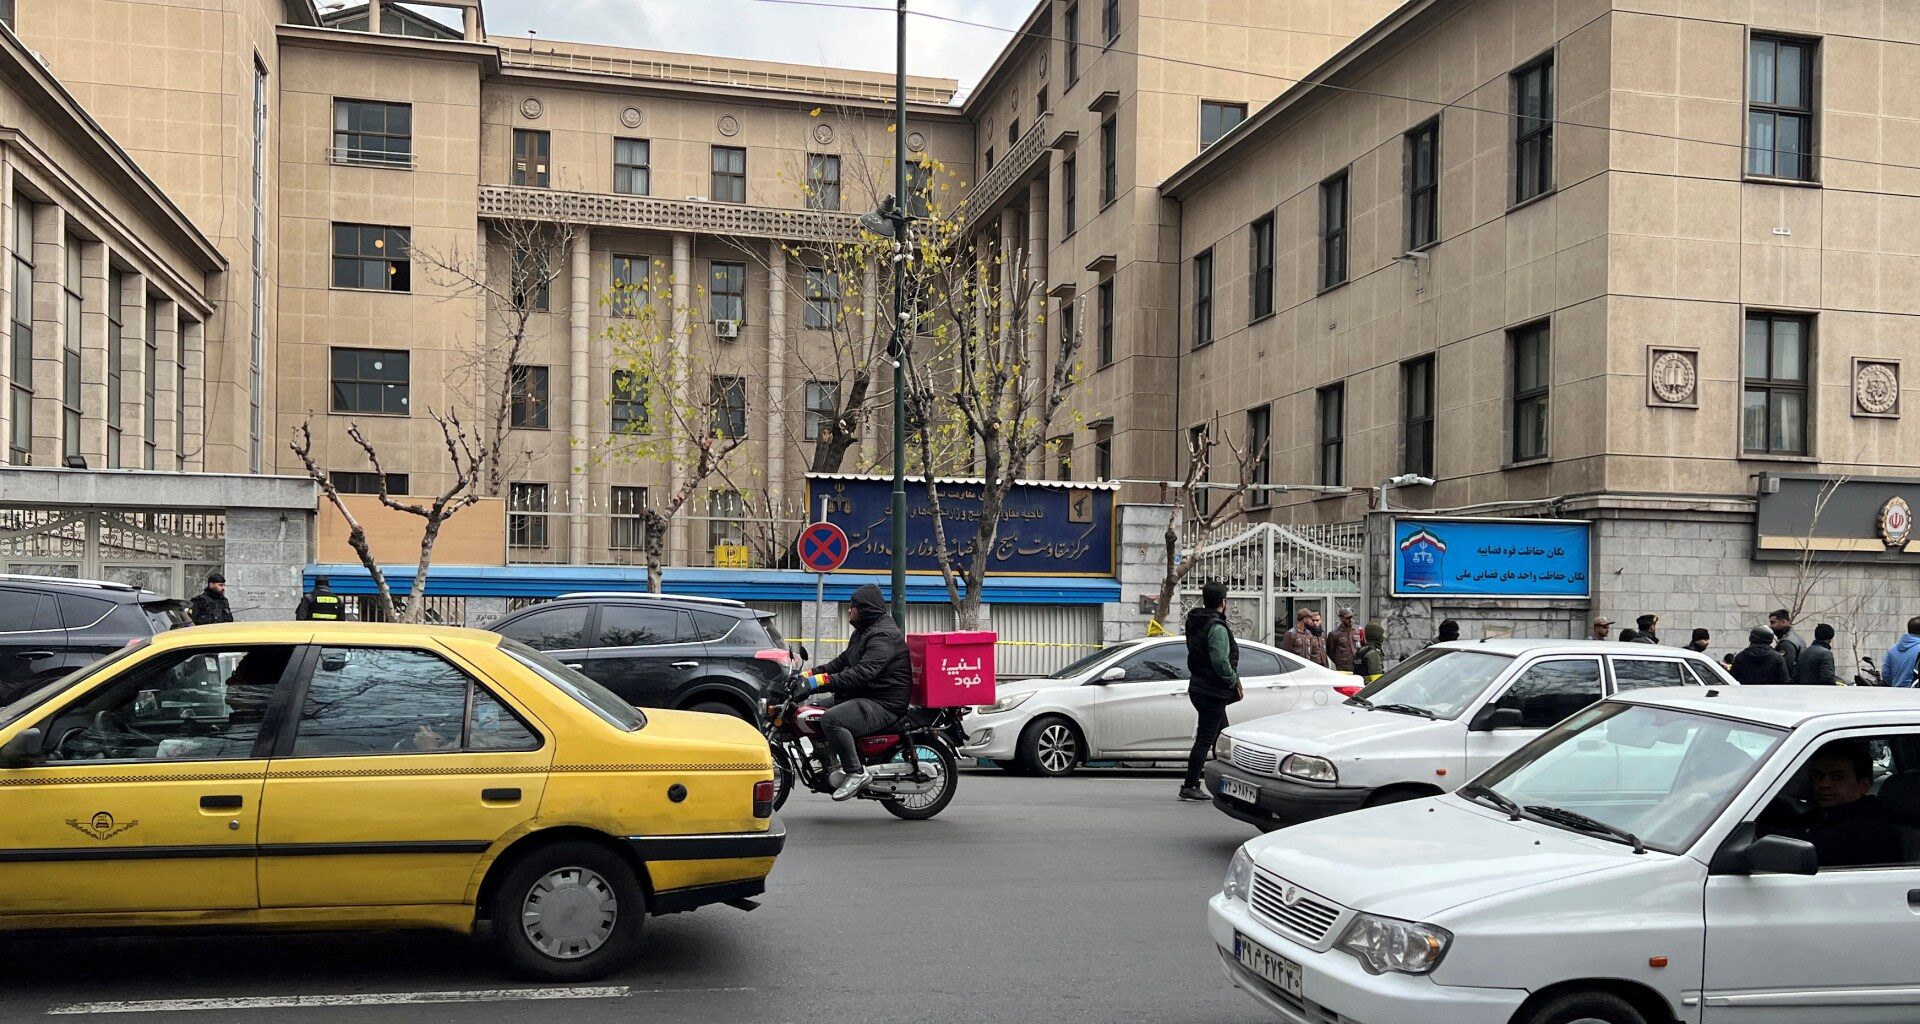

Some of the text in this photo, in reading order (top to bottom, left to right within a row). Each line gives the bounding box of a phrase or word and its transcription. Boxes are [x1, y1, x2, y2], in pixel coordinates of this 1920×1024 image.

[1021, 507, 1043, 521] ناحیه
[995, 531, 1018, 561] بسیج
[1017, 538, 1070, 559] مقاومت
[1067, 523, 1098, 560] مرکز
[1503, 545, 1516, 558] قوه
[1518, 545, 1545, 556] حفاظت
[1547, 545, 1564, 558] یگان
[1456, 568, 1471, 582] ملی
[1500, 569, 1515, 582] های
[1517, 569, 1537, 583] واحد
[1538, 569, 1566, 581] حفاظت
[1567, 571, 1585, 583] یگان
[954, 673, 982, 688] فود
[1264, 953, 1283, 984] ۴۷۴
